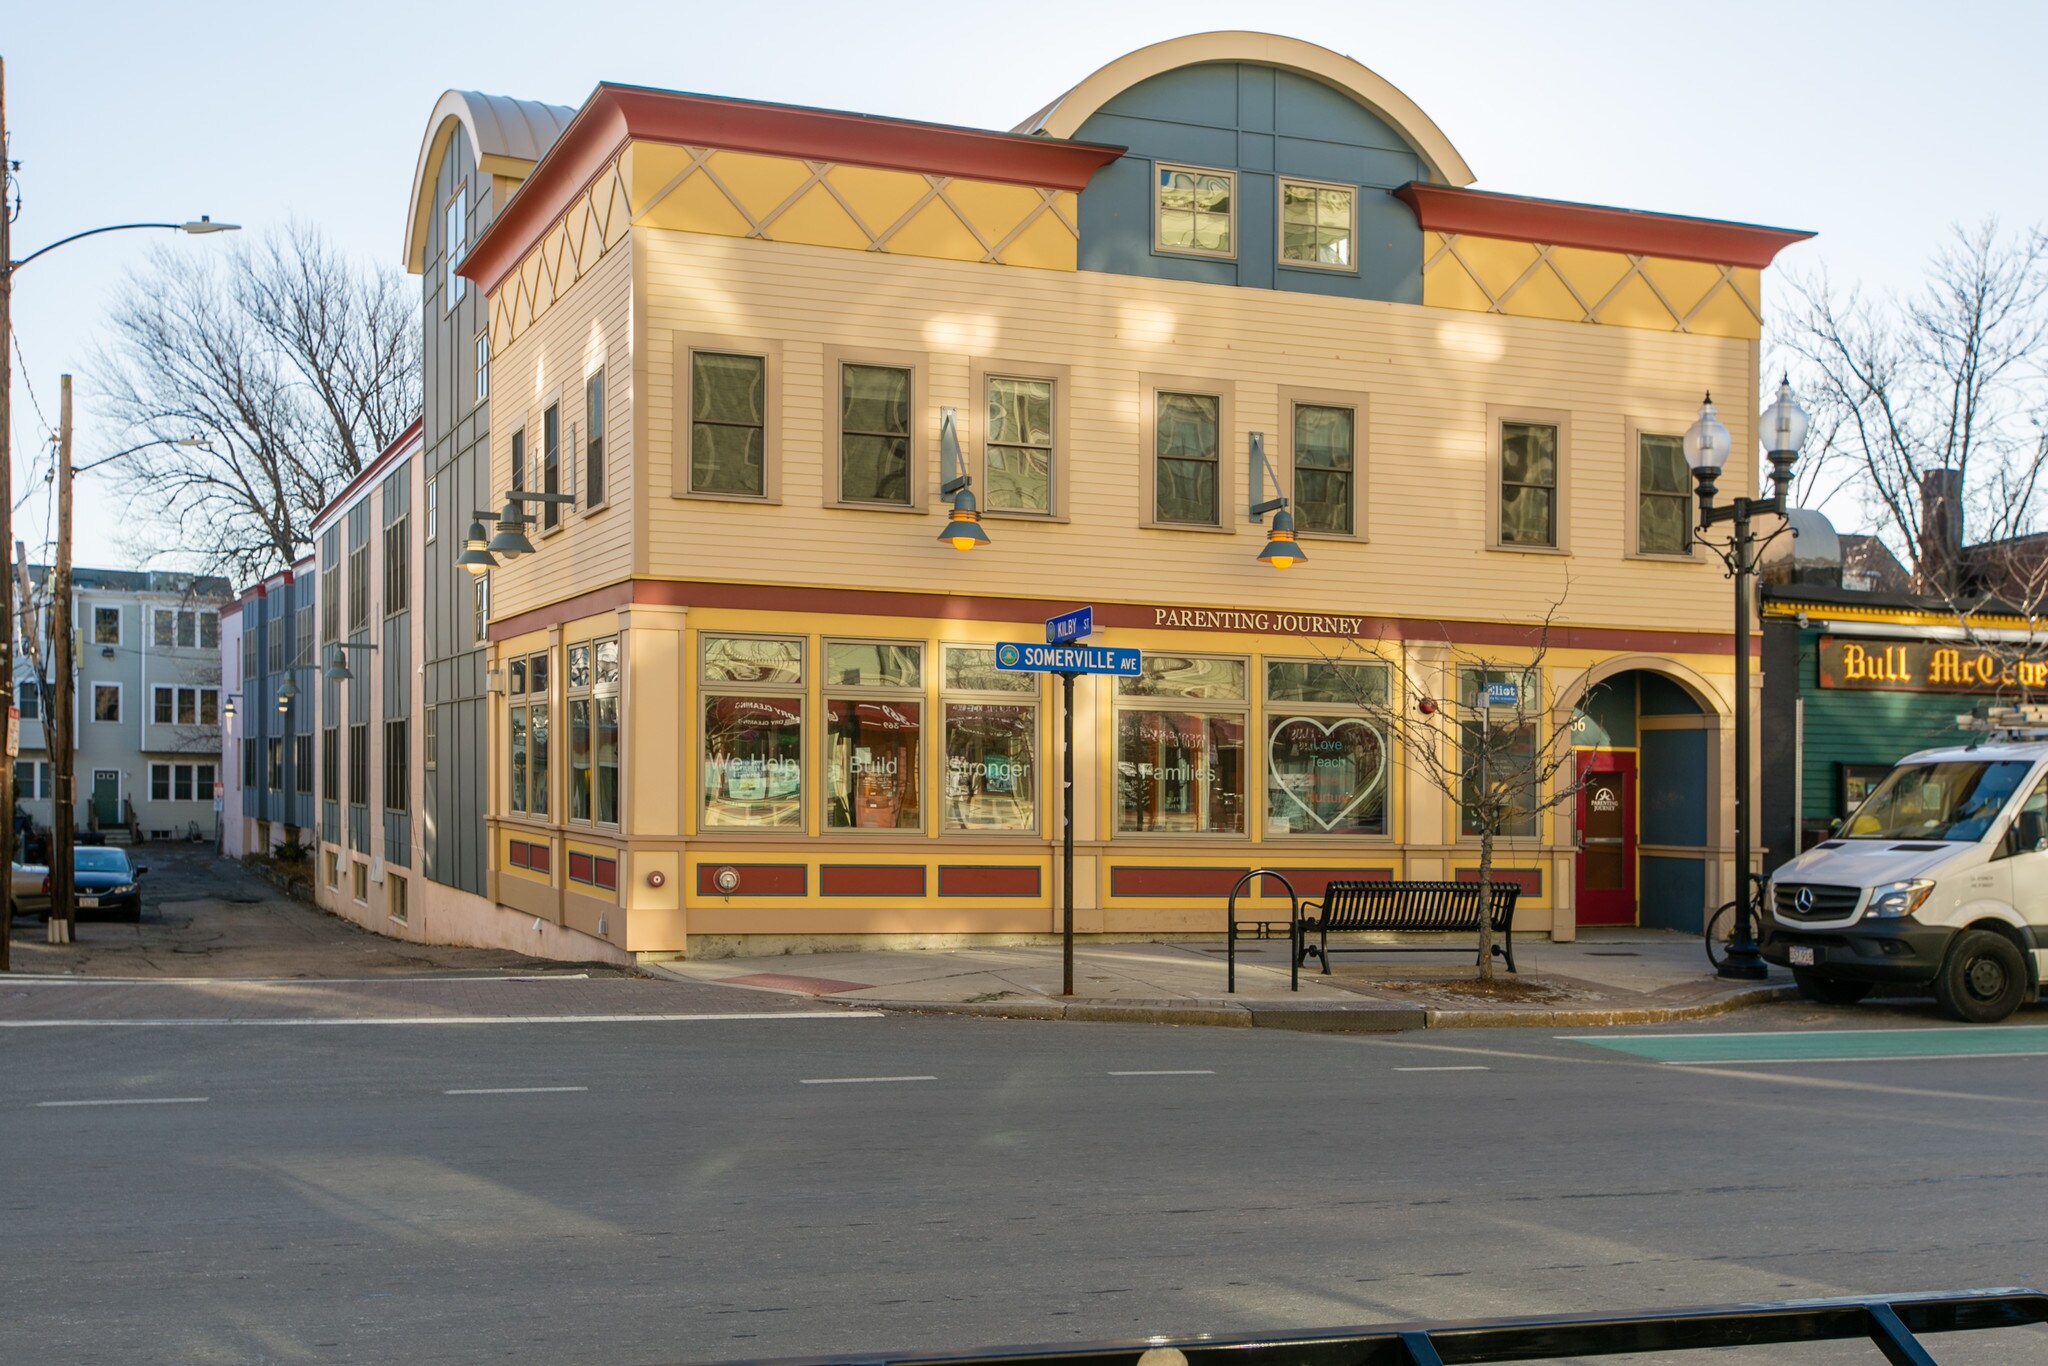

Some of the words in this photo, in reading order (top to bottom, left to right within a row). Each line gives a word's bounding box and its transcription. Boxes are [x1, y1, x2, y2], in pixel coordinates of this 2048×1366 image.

[1057, 618, 1077, 638] KILBY
[1083, 617, 1090, 630] ST
[1154, 608, 1269, 630] PARENTING
[1273, 614, 1363, 635] JOURNEY
[1024, 647, 1116, 669] SOMERVILLE
[1120, 657, 1137, 670] AVE
[1843, 643, 1912, 682] Bull
[1487, 684, 1516, 697] Eliot
[1313, 738, 1343, 751] Love
[708, 752, 743, 774] We
[750, 753, 796, 779] Help
[850, 756, 897, 774] Build
[949, 757, 1030, 781] Stronger
[1309, 755, 1346, 768] Teach
